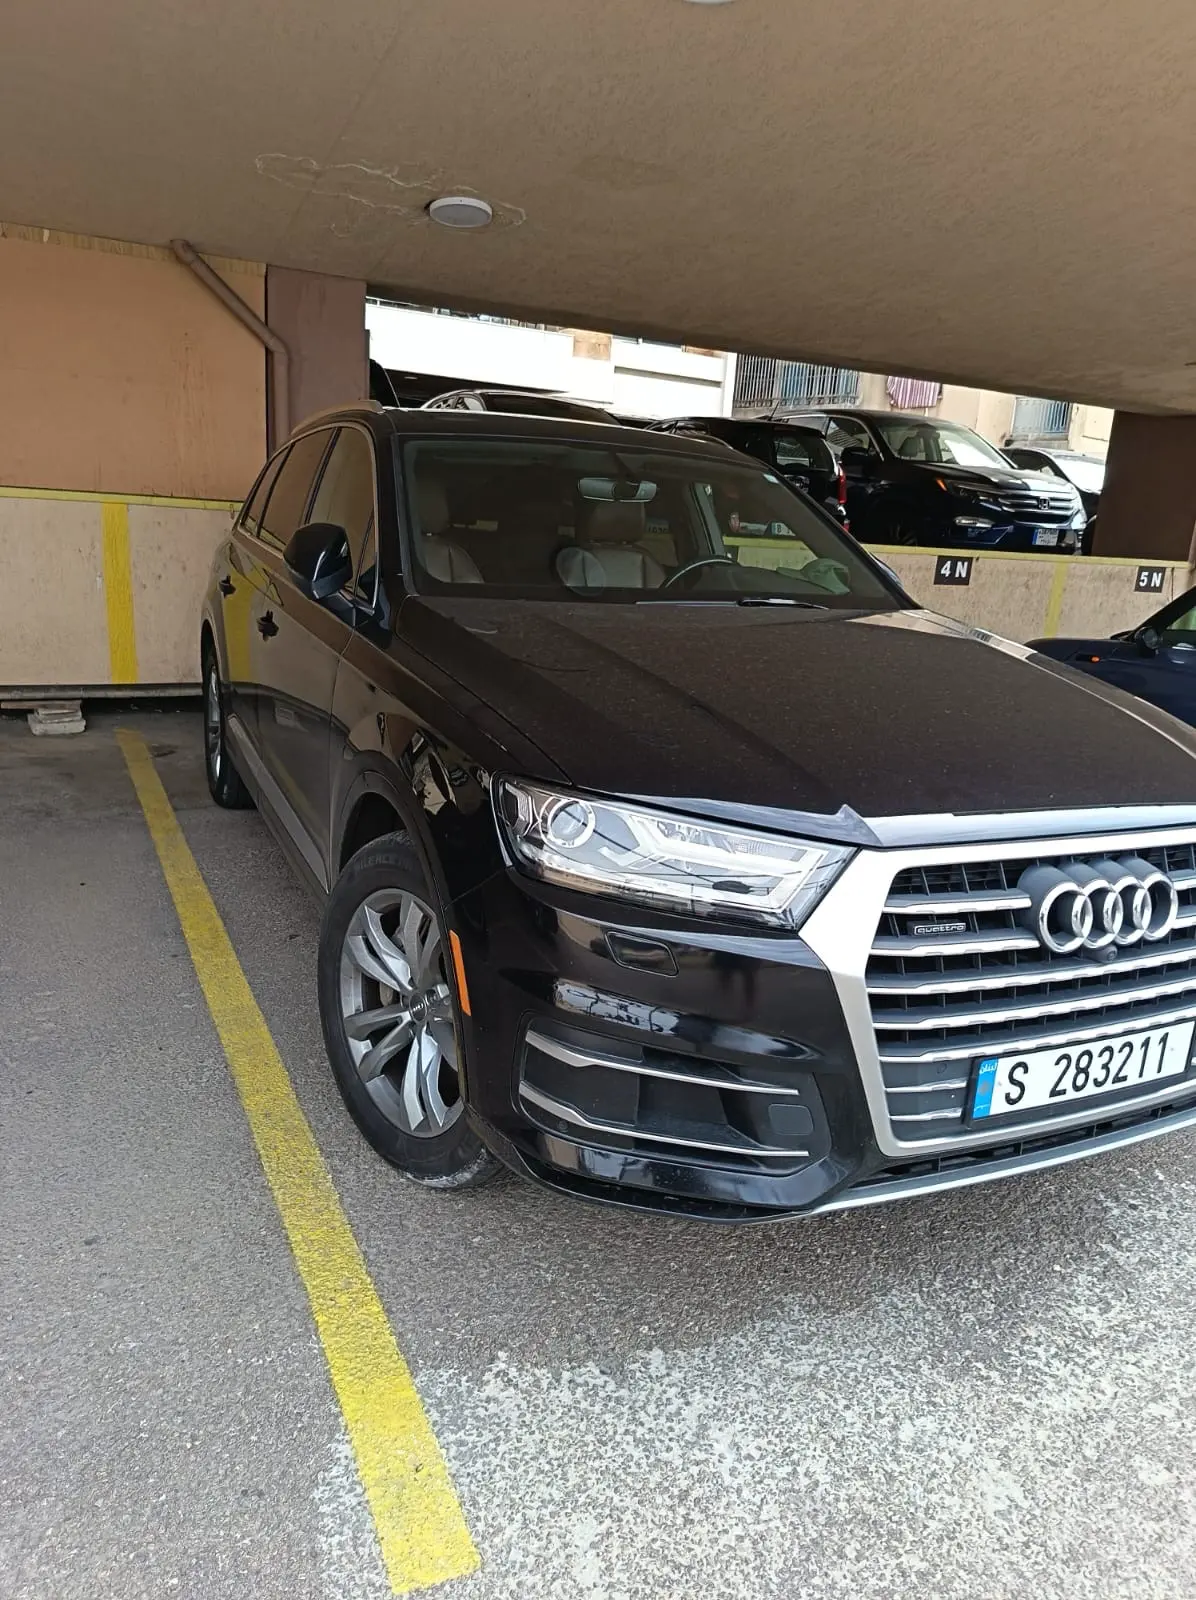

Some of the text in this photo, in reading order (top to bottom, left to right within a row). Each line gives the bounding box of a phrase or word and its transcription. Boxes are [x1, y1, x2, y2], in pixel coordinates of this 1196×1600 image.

[940, 561, 968, 578] 4 N
[1139, 571, 1162, 588] 5 N
[917, 925, 965, 935] quattro
[1004, 1031, 1169, 1106] S 283211
